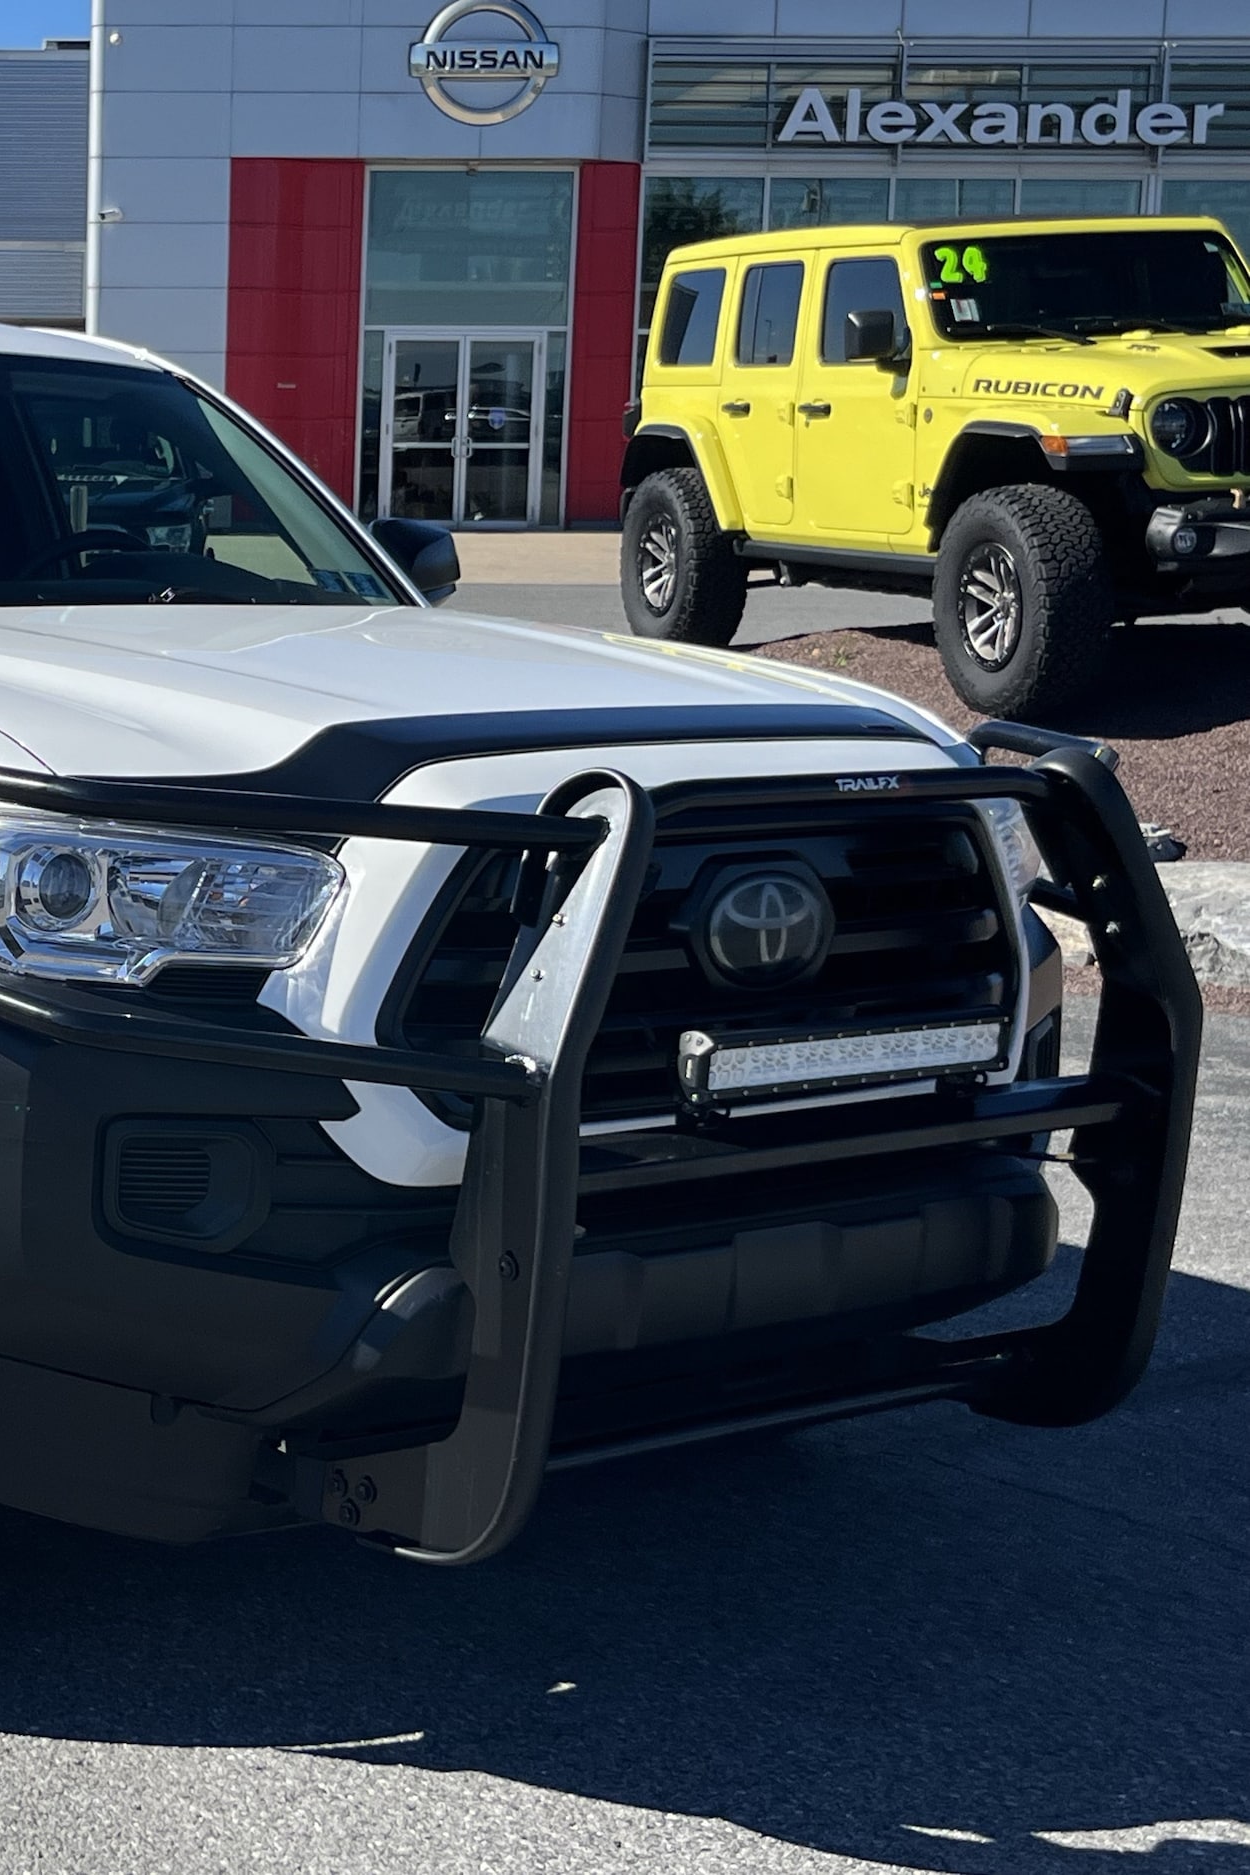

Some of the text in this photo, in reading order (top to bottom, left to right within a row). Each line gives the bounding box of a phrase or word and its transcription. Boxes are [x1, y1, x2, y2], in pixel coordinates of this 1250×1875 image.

[426, 50, 543, 69] NISSAN
[777, 88, 1225, 146] Alexander
[934, 246, 987, 283] 24
[972, 379, 1104, 400] RUBICON
[835, 775, 899, 792] TRAILFX
